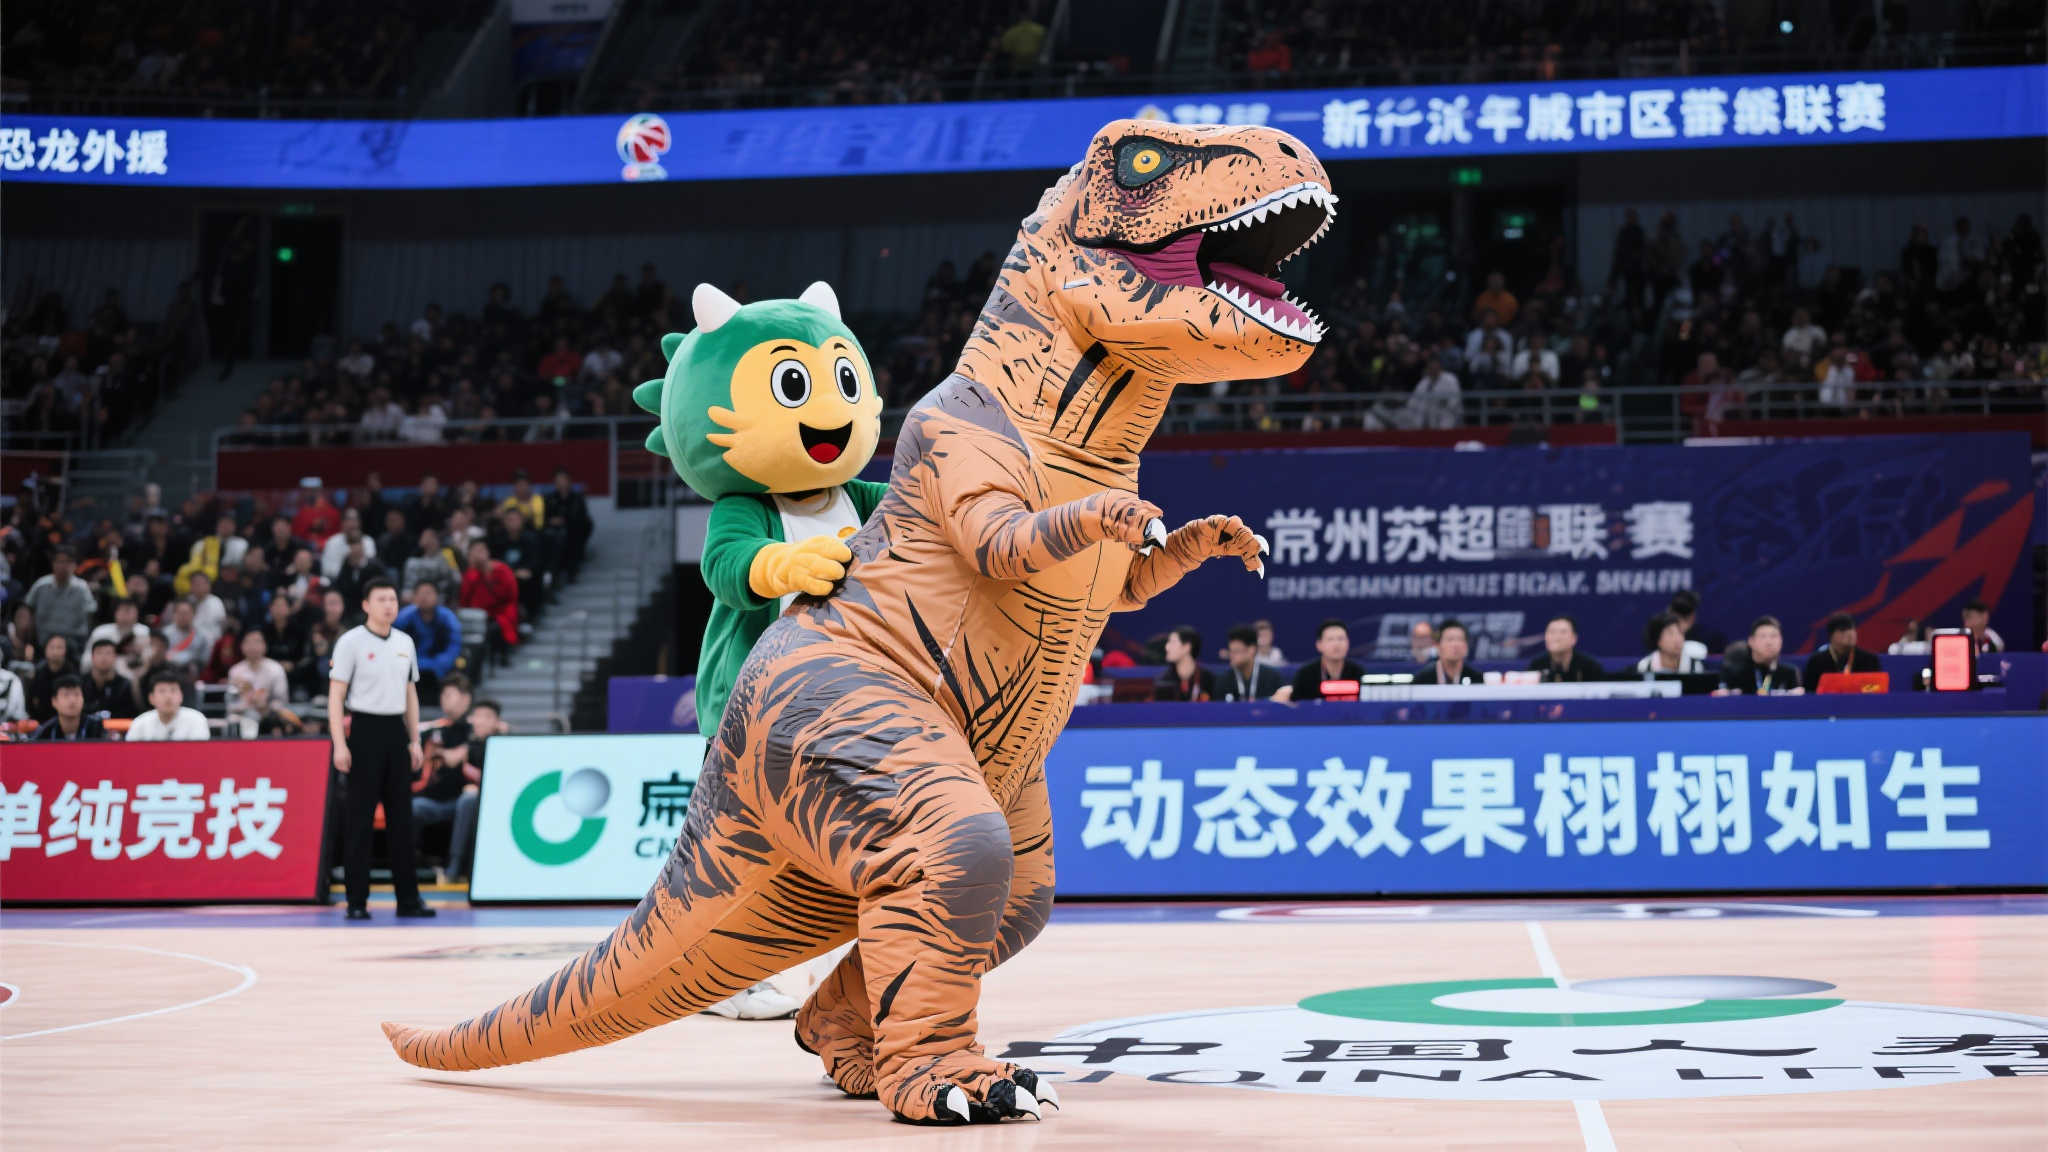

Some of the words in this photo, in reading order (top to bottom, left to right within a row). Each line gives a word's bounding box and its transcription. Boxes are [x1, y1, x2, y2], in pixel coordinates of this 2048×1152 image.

[0, 777, 288, 861] 单纯竞技
[1080, 748, 1990, 860] 动态效果栩栩如生
